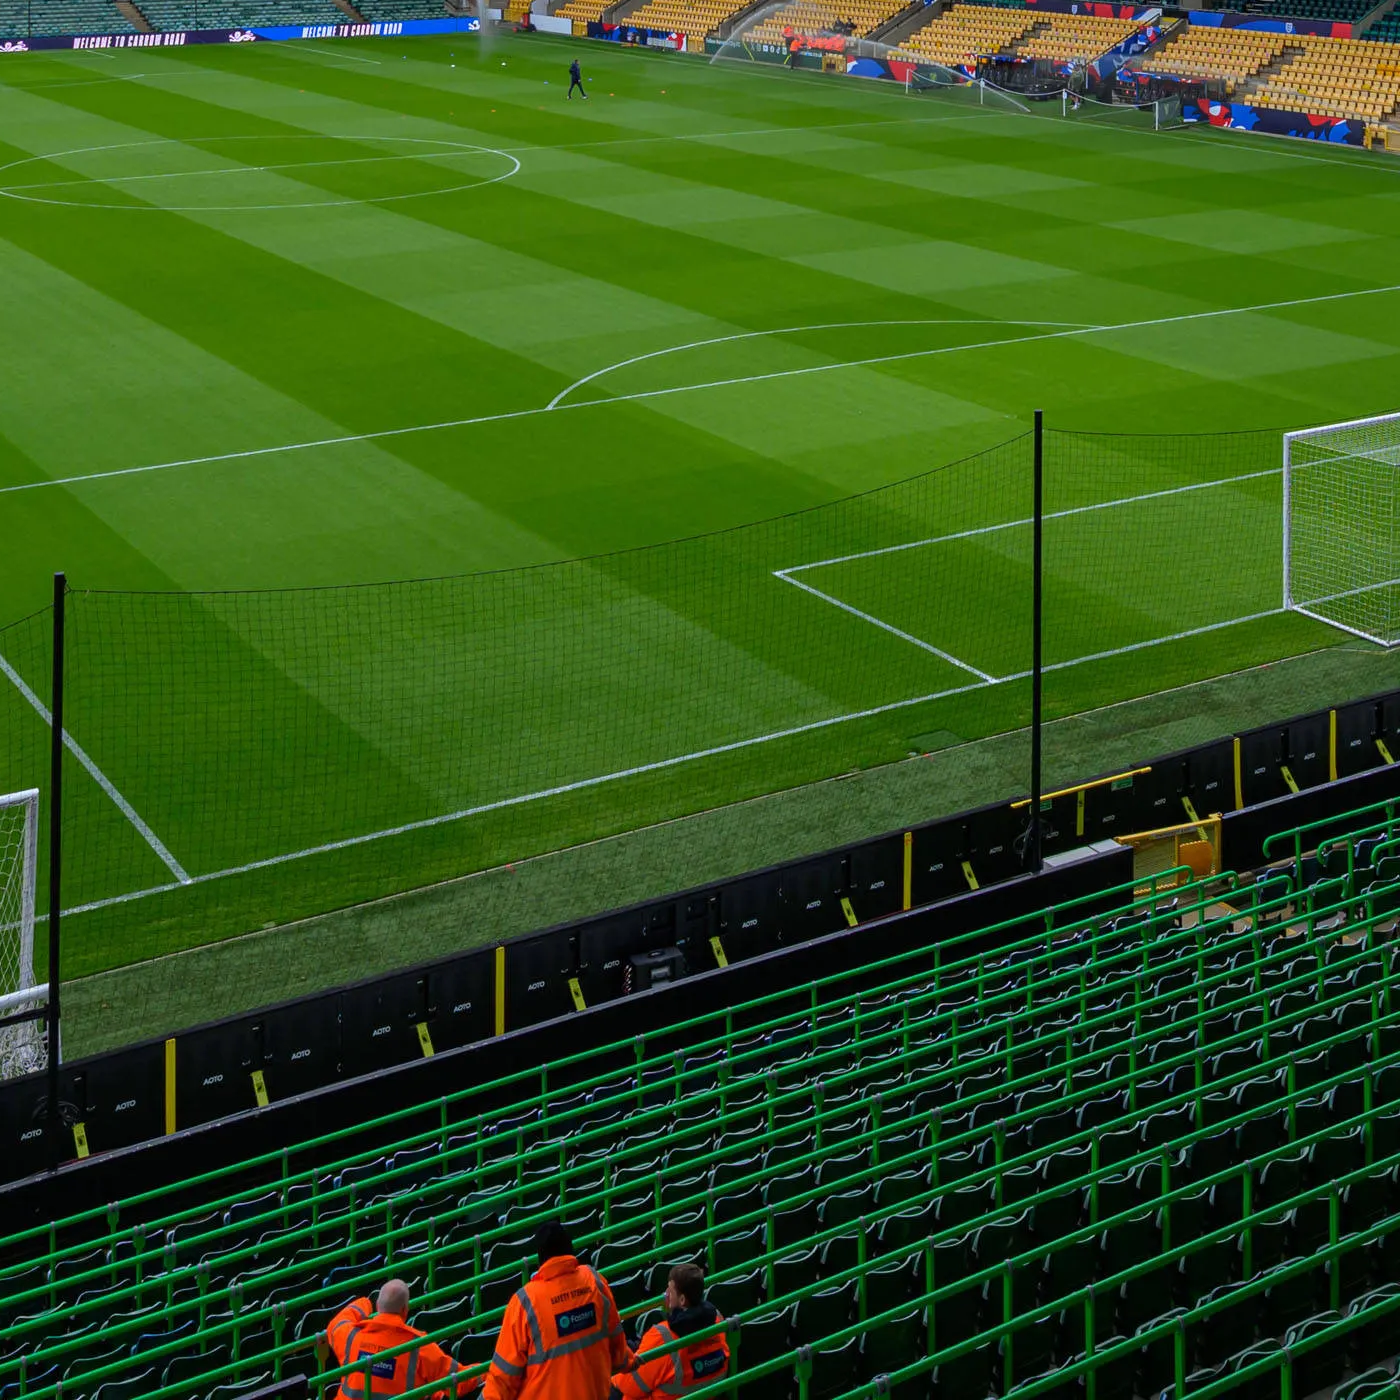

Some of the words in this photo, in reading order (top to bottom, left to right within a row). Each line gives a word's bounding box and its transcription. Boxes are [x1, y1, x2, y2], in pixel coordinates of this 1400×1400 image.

[302, 25, 337, 38] WELCOME
[338, 24, 349, 37] TO
[350, 23, 382, 36] CARROW
[383, 22, 403, 35] ROAD
[73, 35, 113, 49] WELCOME
[115, 35, 126, 48] TO
[127, 34, 164, 47] CARROW
[165, 33, 186, 46] ROAD
[870, 881, 884, 889] AOTO
[807, 900, 821, 909] AOTO
[742, 919, 757, 928] AOTO
[604, 960, 620, 970] AOTO
[528, 981, 545, 991] AOTO
[454, 1003, 471, 1013] AOTO
[373, 1026, 391, 1036] AOTO
[291, 1049, 311, 1060] AOTO
[203, 1075, 223, 1085] AOTO
[115, 1100, 136, 1111] AOTO
[21, 1129, 42, 1140] AOTO
[551, 1292, 570, 1305] SAFETY
